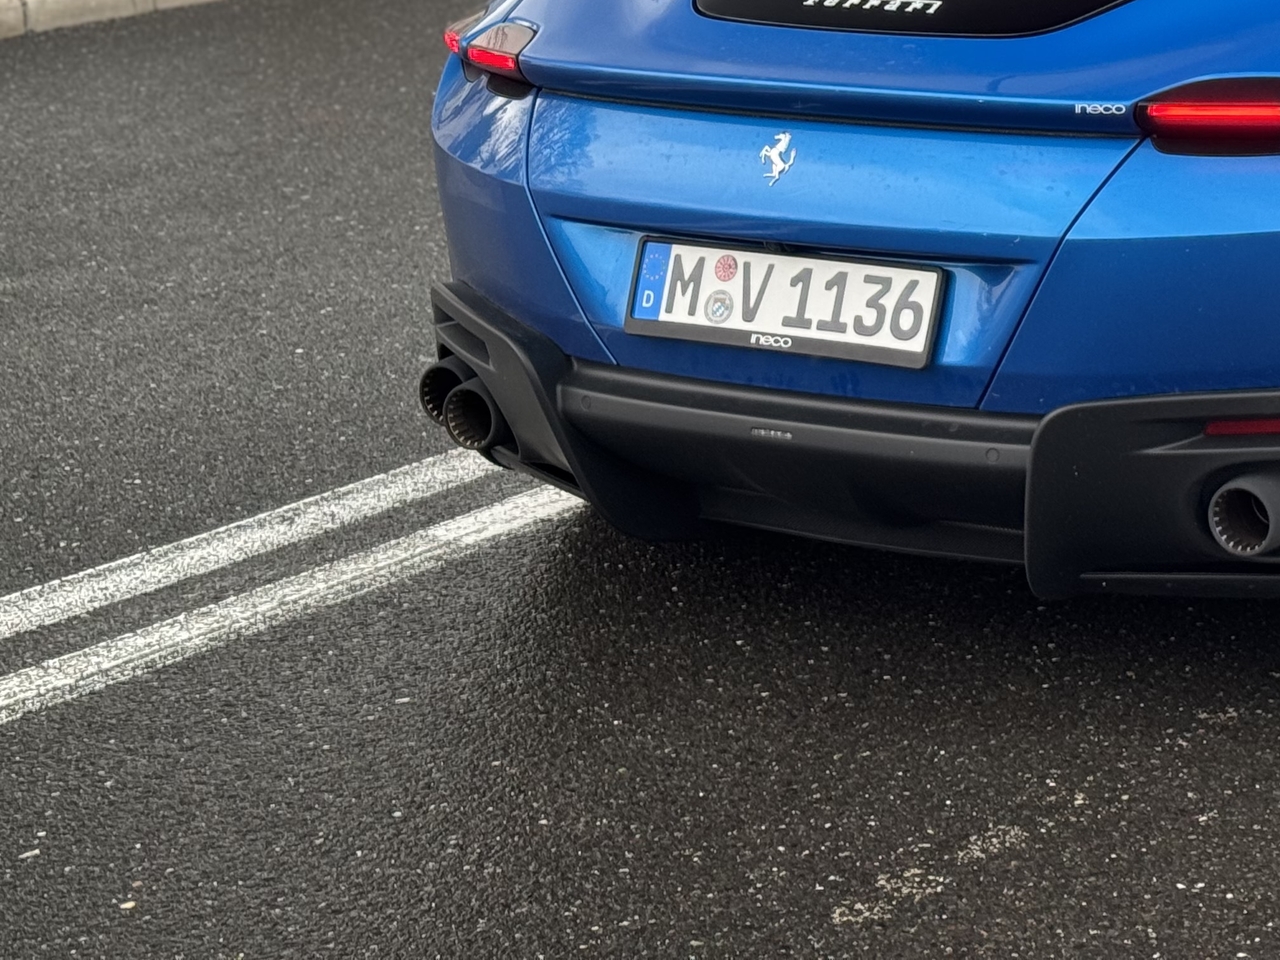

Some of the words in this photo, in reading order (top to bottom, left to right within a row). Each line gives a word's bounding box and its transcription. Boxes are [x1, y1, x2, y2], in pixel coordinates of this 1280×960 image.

[1075, 103, 1126, 115] ineco
[641, 290, 654, 308] D
[664, 253, 705, 316] M
[742, 261, 775, 323] V
[781, 267, 924, 341] 1136
[750, 333, 792, 348] ineco
